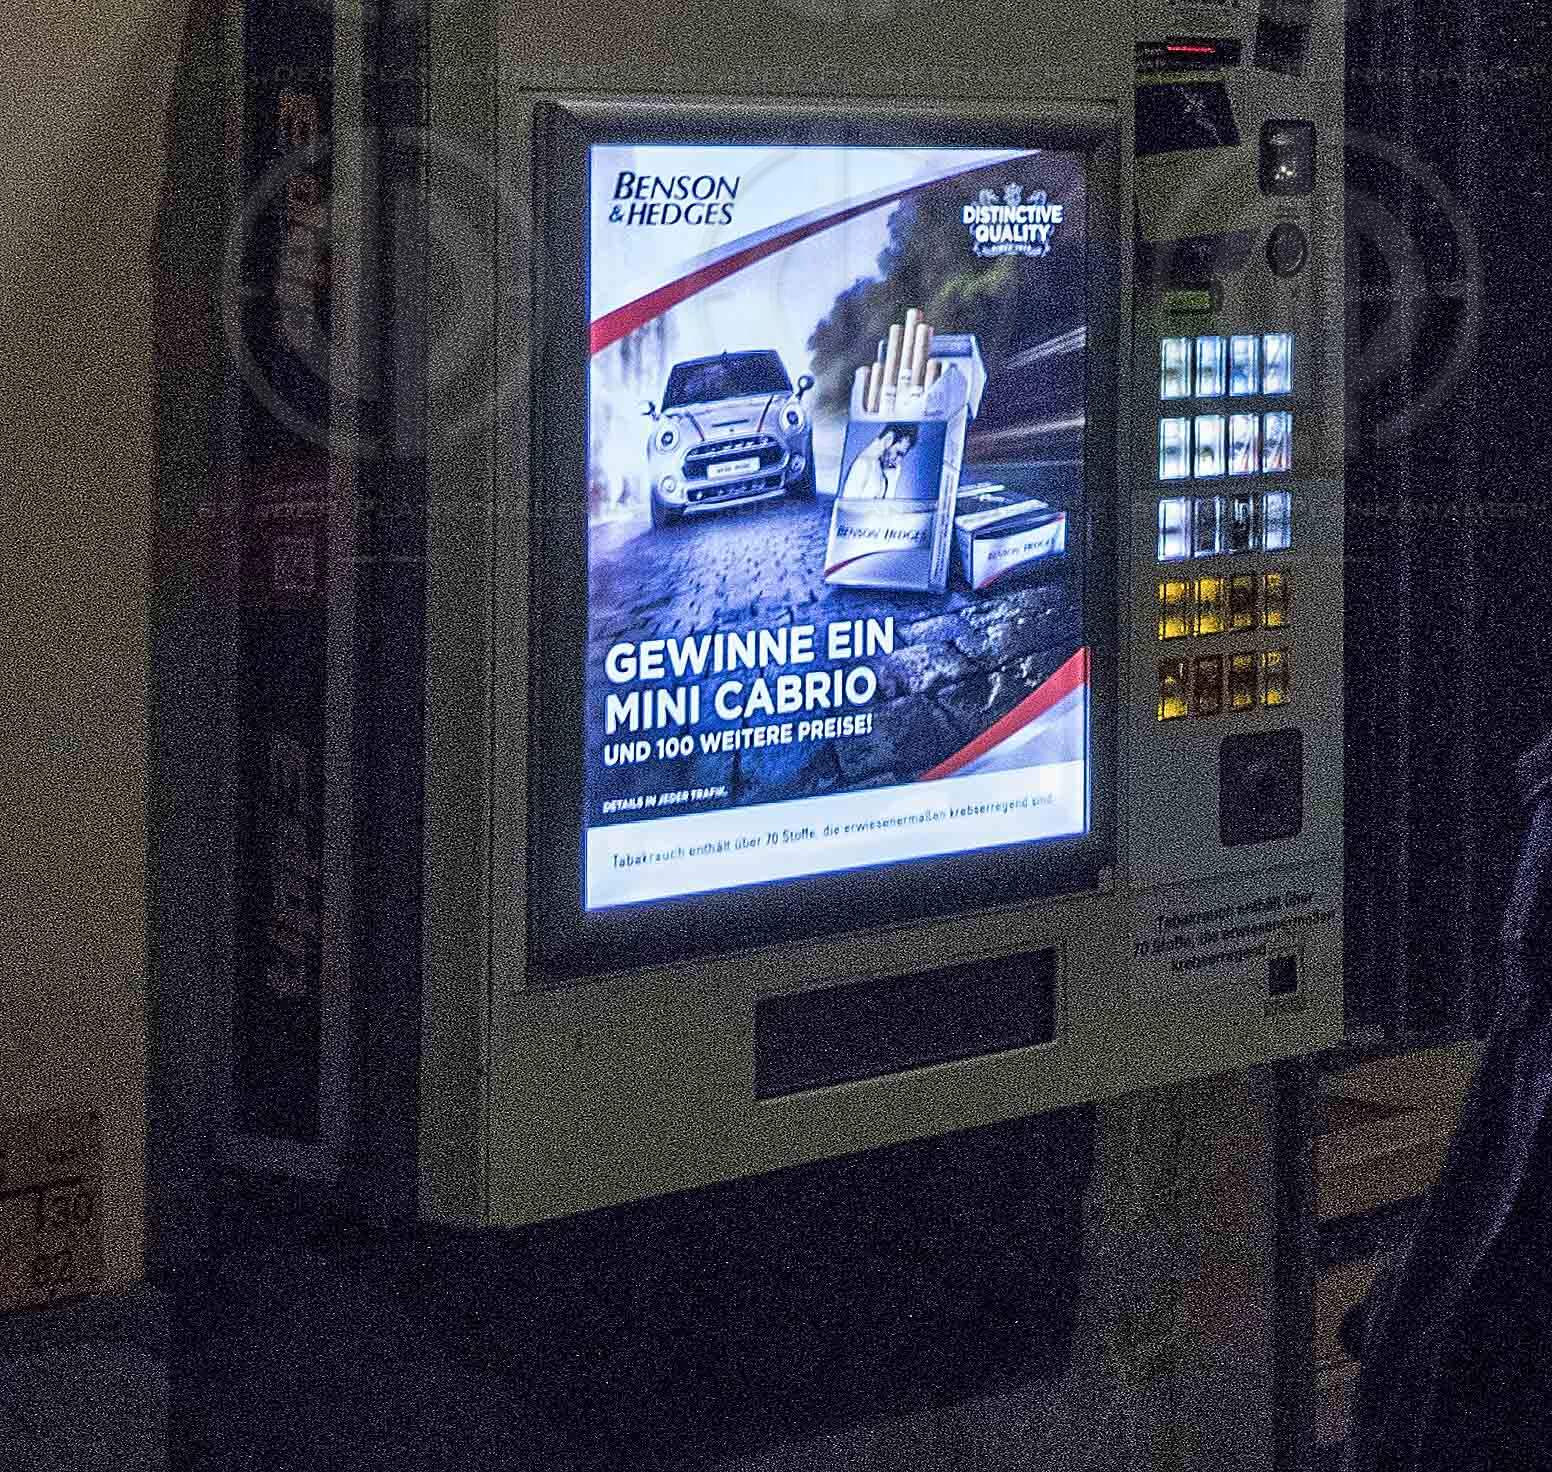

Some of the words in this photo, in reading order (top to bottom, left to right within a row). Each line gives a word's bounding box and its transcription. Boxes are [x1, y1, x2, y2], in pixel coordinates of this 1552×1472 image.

[612, 169, 741, 200] BENSON
[626, 201, 735, 225] HEDGES
[963, 204, 1063, 224] DISTINCTIVE
[975, 223, 1051, 243] QUALITY
[604, 625, 815, 684] GEWINNE
[827, 616, 894, 660] EIN
[605, 685, 701, 736] MINI
[713, 665, 878, 721] CABRIO
[603, 742, 652, 767] UND
[656, 734, 694, 760] 100
[700, 723, 793, 754] WEITERE
[798, 712, 874, 742] PREISE!
[603, 797, 643, 813] DETAILS
[645, 795, 657, 807] IN
[658, 790, 691, 806] JEDER
[613, 847, 686, 869] Tabakrauch
[689, 841, 732, 858] enthält
[735, 836, 762, 851] über
[823, 823, 840, 839] die
